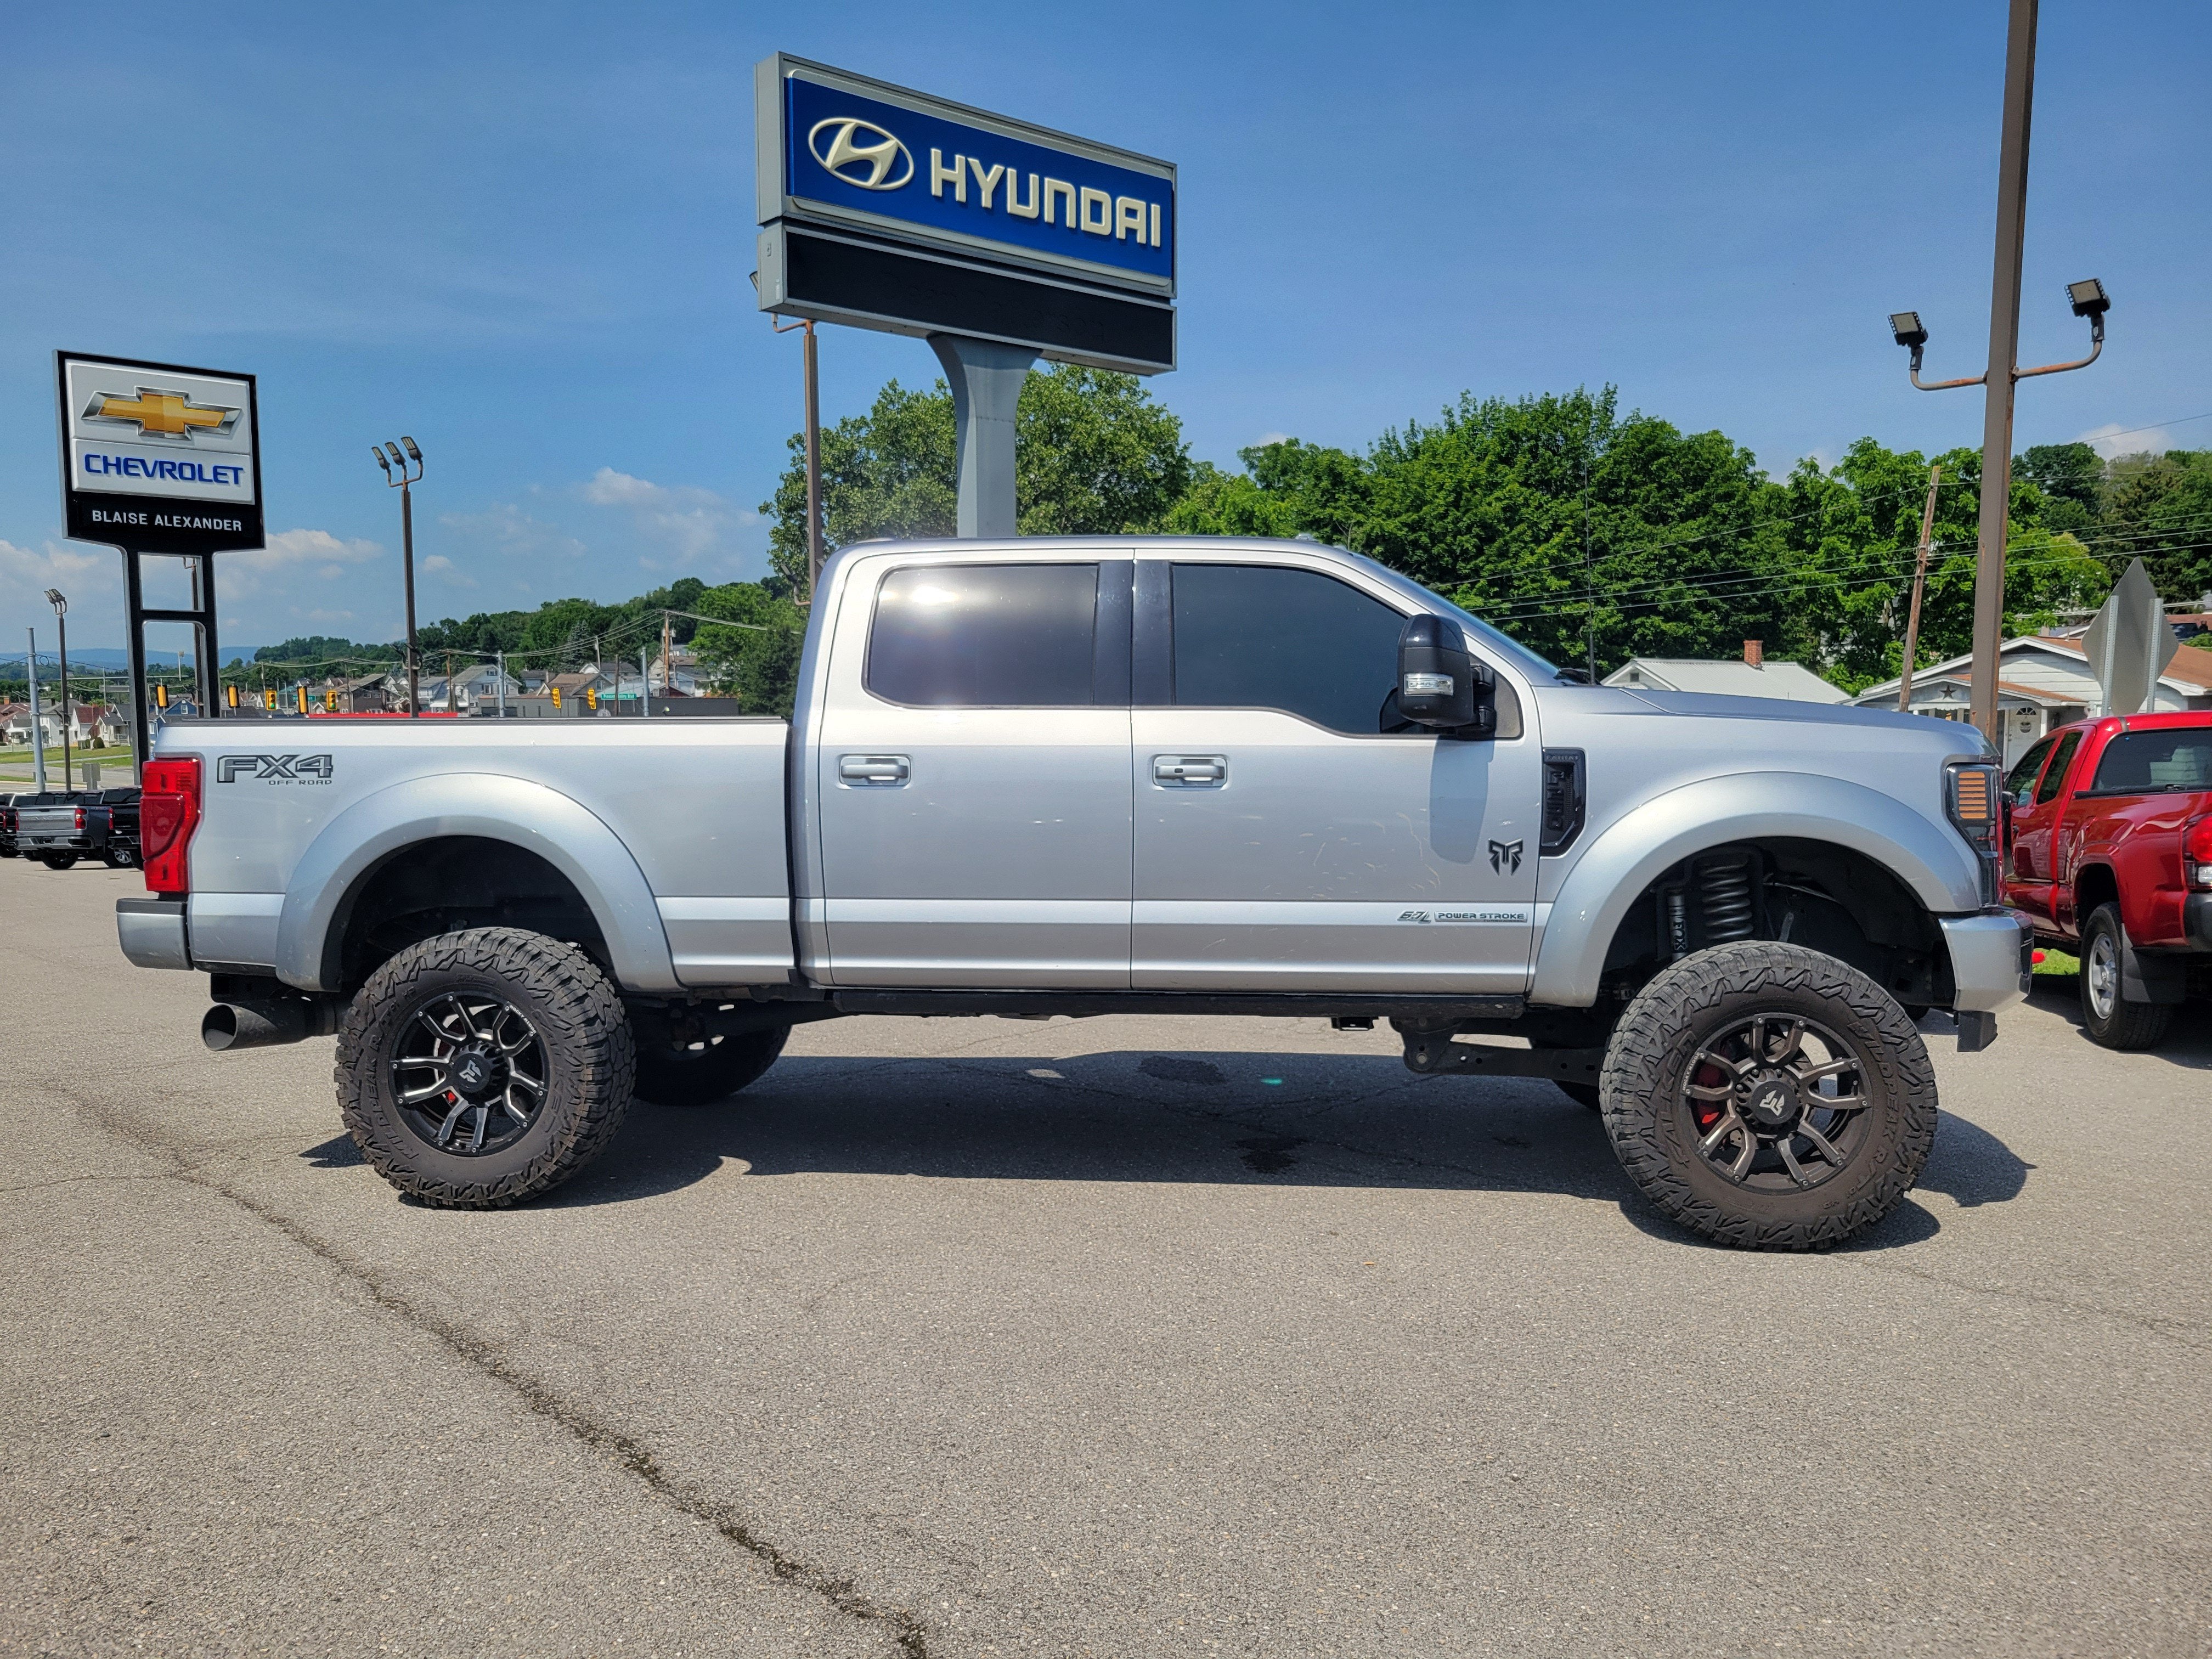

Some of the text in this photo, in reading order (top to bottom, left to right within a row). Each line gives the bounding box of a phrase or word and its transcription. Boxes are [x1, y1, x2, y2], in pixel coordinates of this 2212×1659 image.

[930, 148, 1161, 247] HYUNDAI
[84, 454, 244, 484] CHEVROLET
[92, 510, 242, 532] BLAISE ALEXANDER
[217, 754, 334, 783] FX4
[1672, 921, 1687, 950] FOX
[509, 1005, 525, 1018] ROCKY
[1682, 1070, 1690, 1091] ROCKY
[1846, 1022, 1899, 1141] WILDPEAK
[365, 1058, 420, 1160] WILDPEAK
[1659, 1030, 1697, 1169] FALKEN
